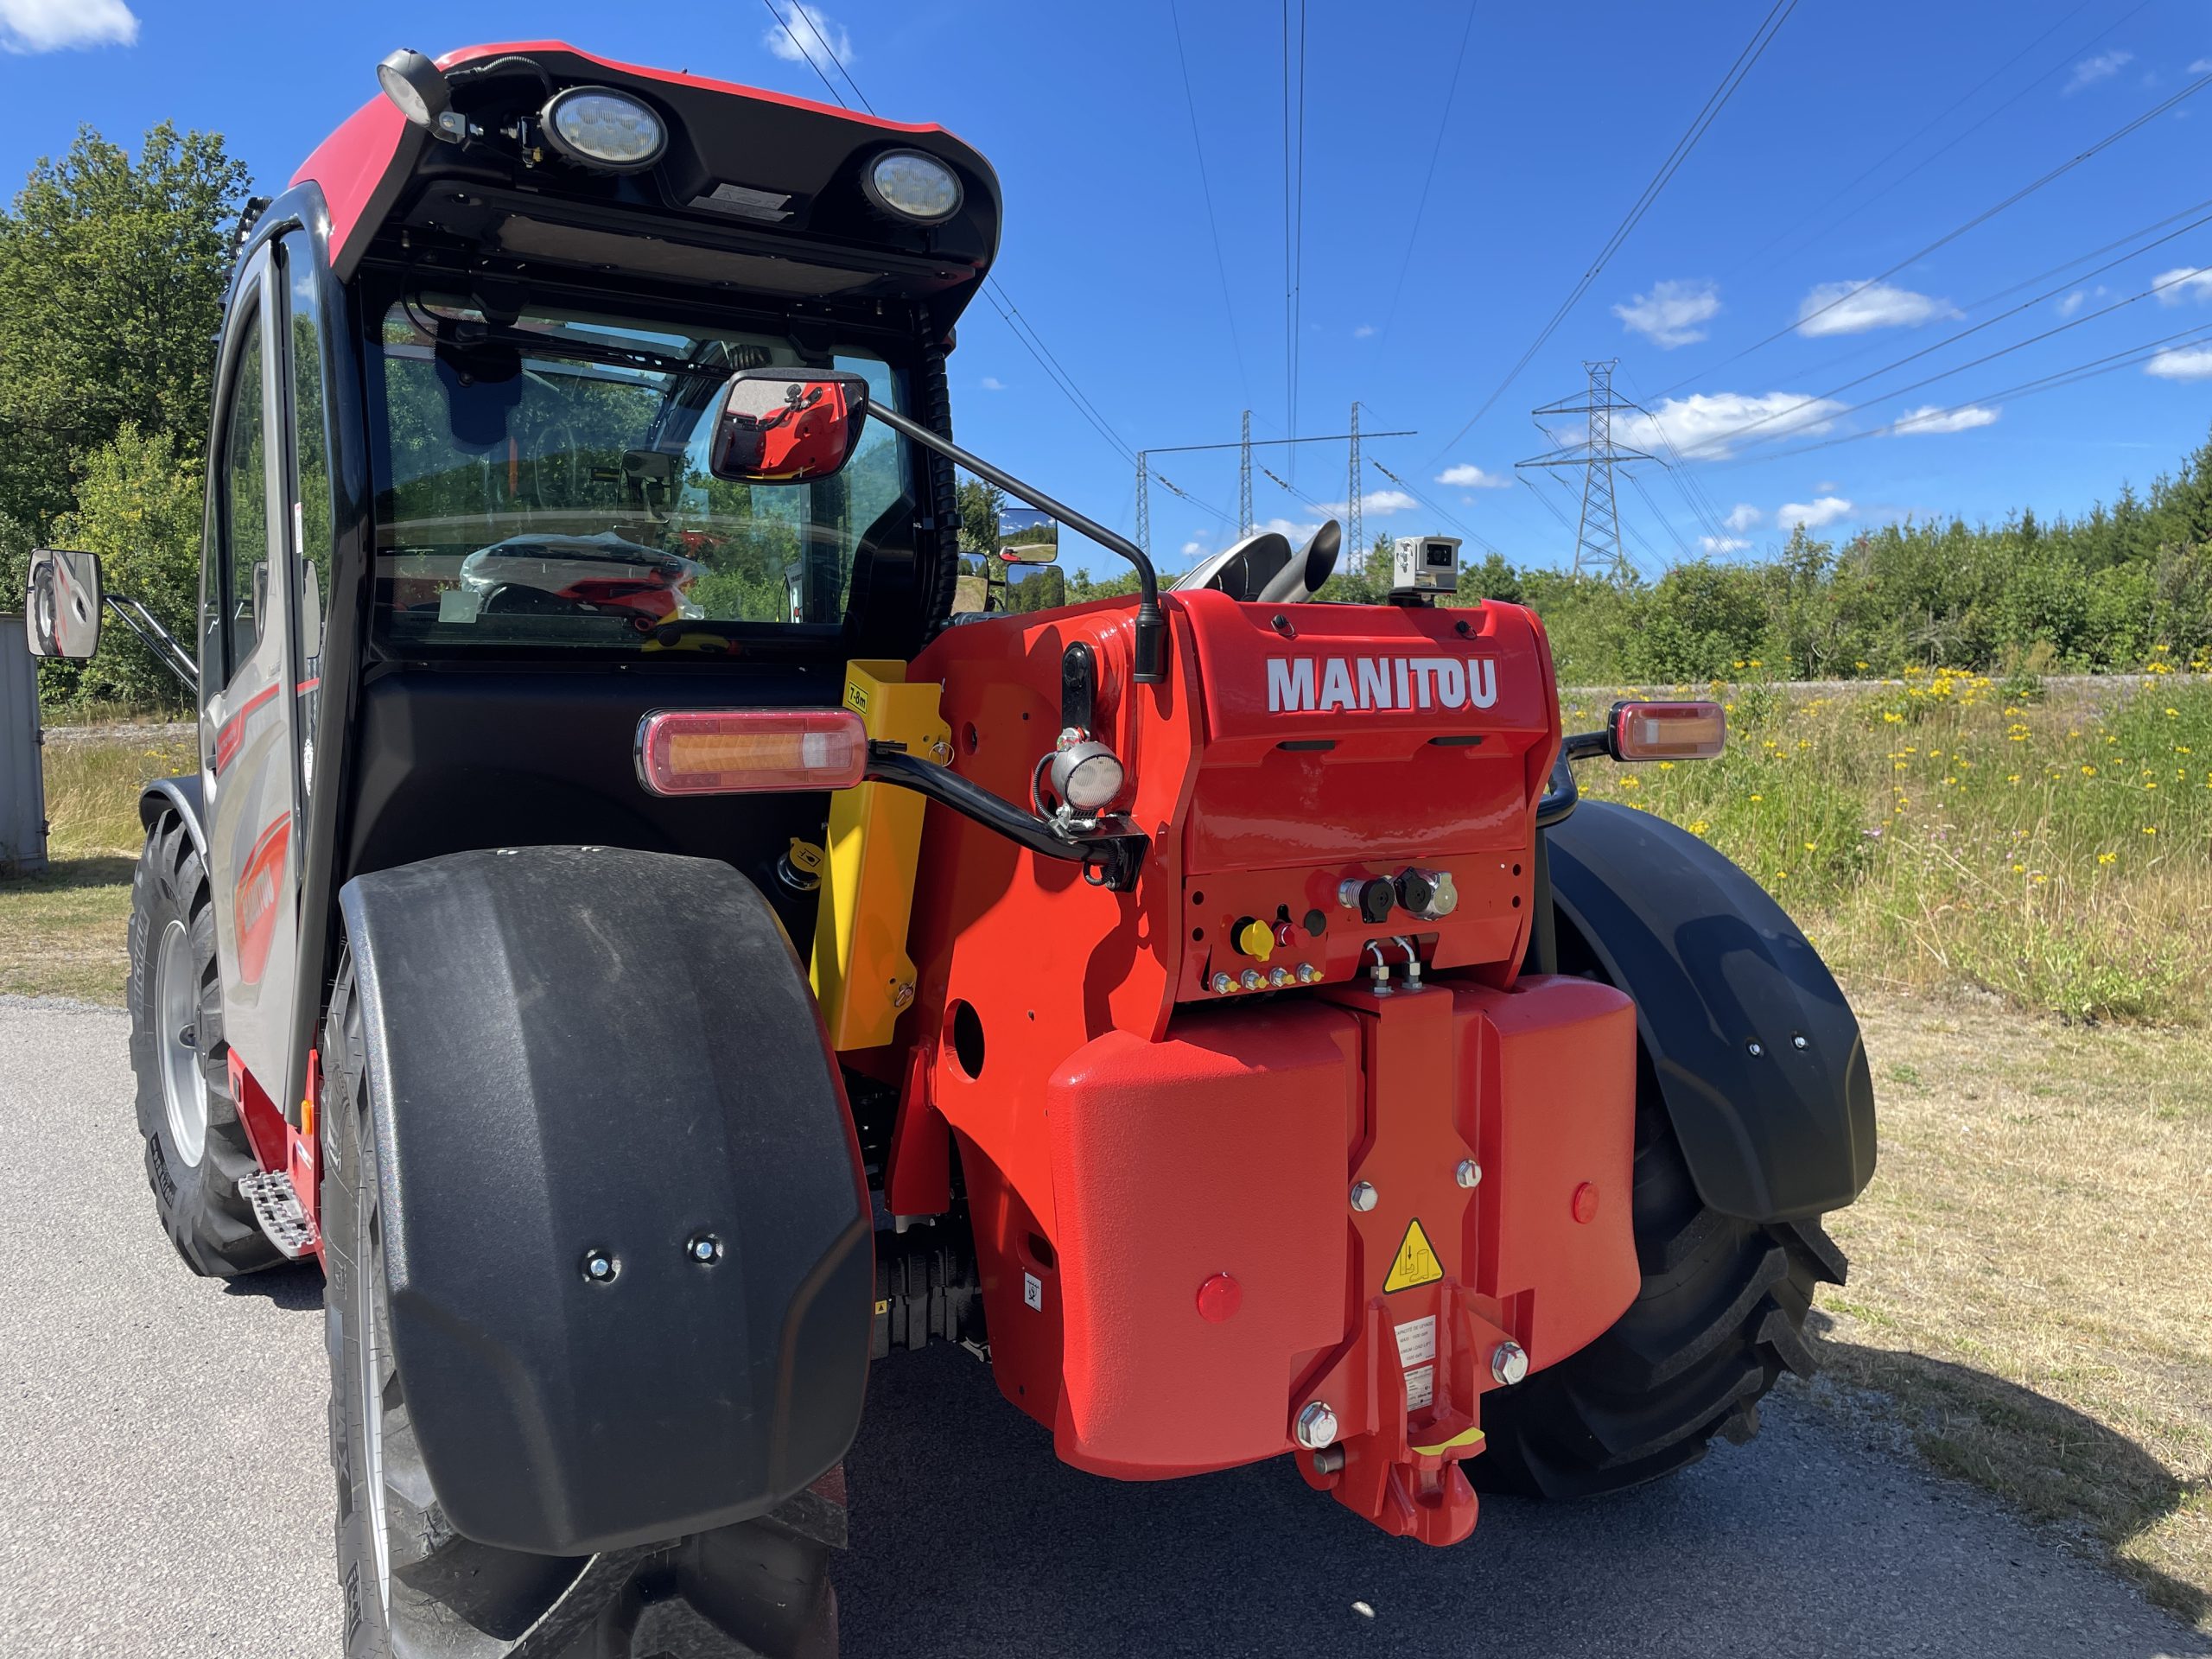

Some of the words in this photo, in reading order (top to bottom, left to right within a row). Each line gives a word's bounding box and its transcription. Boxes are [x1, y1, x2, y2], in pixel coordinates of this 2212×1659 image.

[850, 687, 866, 709] 7-8m
[1267, 658, 1497, 712] MANITOU
[242, 862, 275, 933] MANITOU
